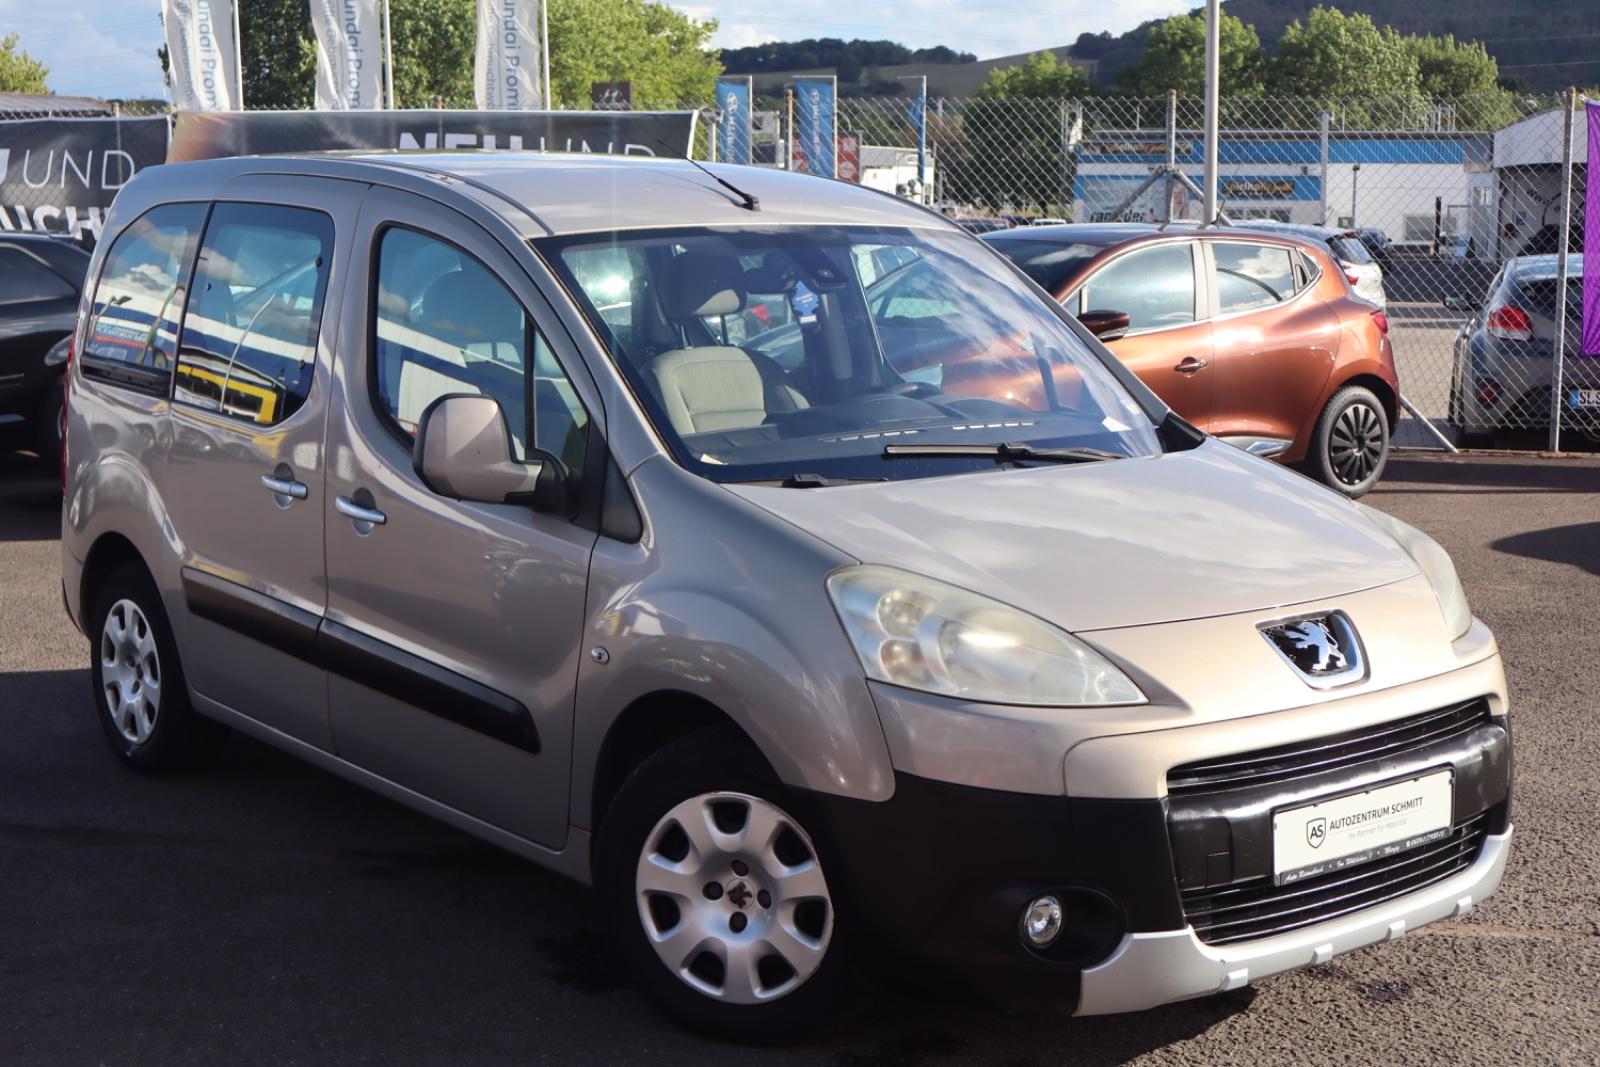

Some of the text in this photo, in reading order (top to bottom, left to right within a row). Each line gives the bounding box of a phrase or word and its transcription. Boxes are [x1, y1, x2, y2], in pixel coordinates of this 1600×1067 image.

[23, 149, 135, 190] UND
[1329, 796, 1423, 831] AUTOZENTRUM SCHMITT
[1309, 824, 1324, 841] AS
